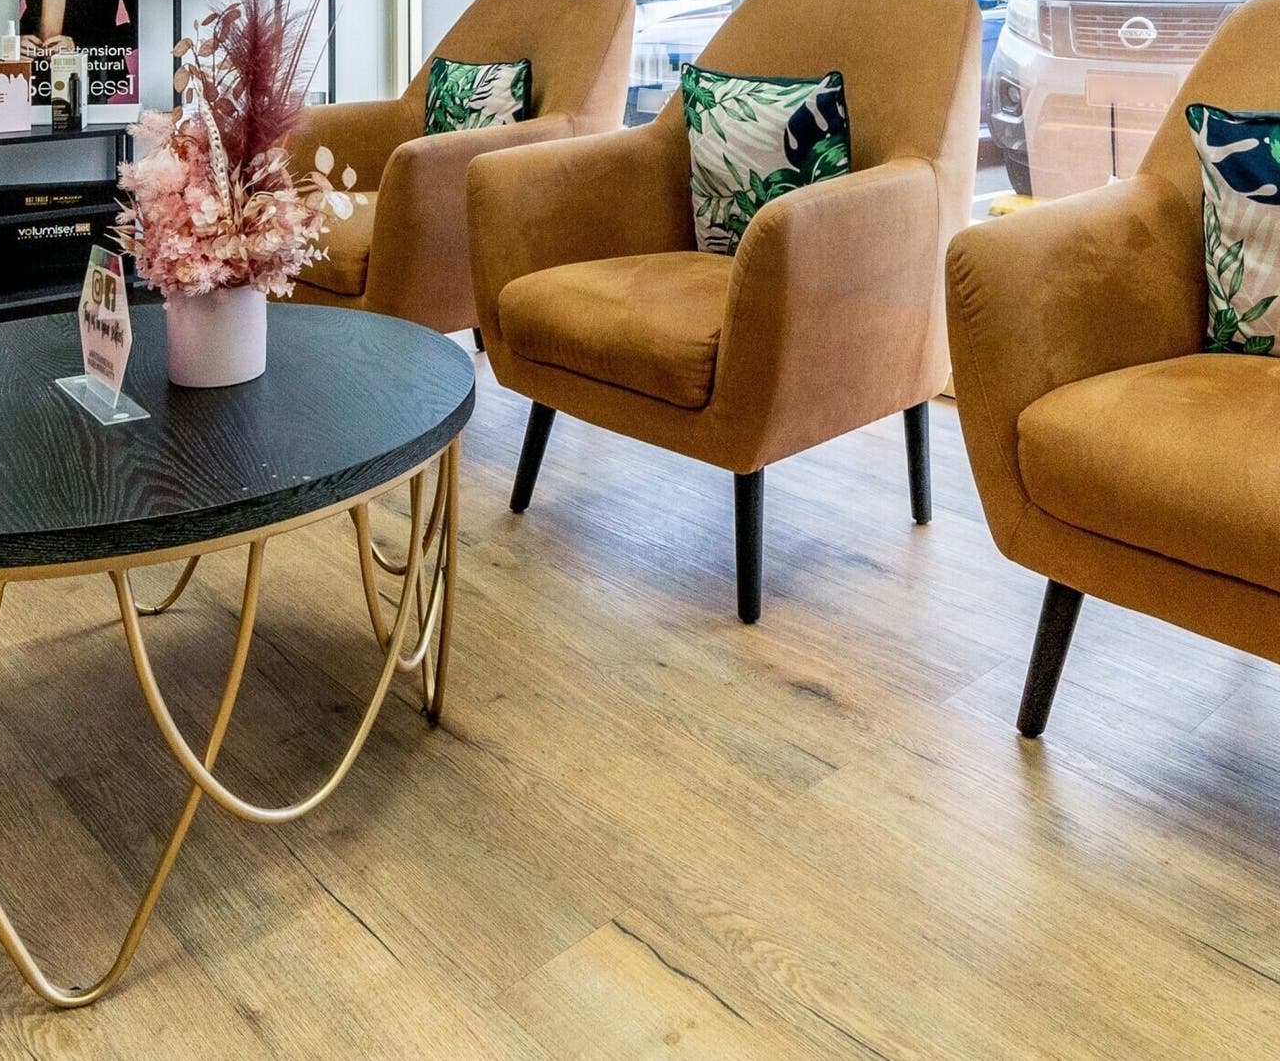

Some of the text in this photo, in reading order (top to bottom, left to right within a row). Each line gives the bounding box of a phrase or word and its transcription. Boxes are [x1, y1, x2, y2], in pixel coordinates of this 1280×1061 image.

[26, 45, 132, 57] Hair Etensions
[87, 59, 125, 71] atural
[18, 224, 75, 236] volumiser
